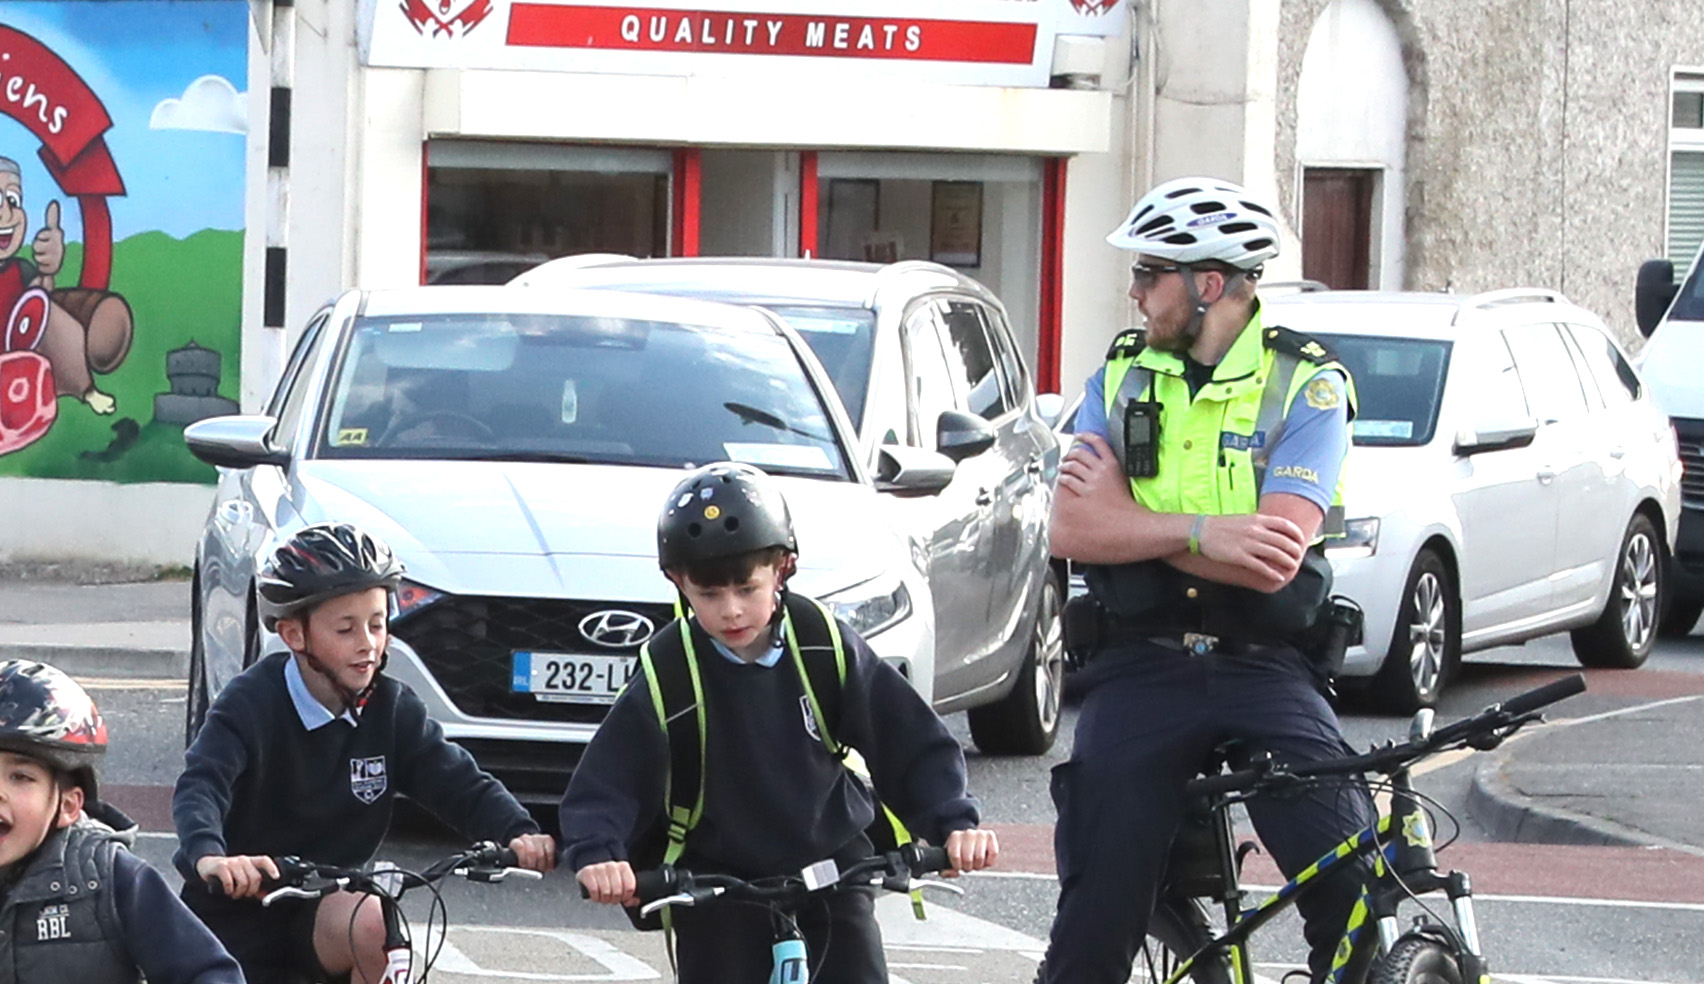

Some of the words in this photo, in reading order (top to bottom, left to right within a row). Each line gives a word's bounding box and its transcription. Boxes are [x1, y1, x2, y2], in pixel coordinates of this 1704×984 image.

[620, 15, 783, 46] QUALITY
[805, 22, 922, 51] MEATS
[1273, 465, 1319, 484] GARDA
[36, 916, 72, 940] RBL
